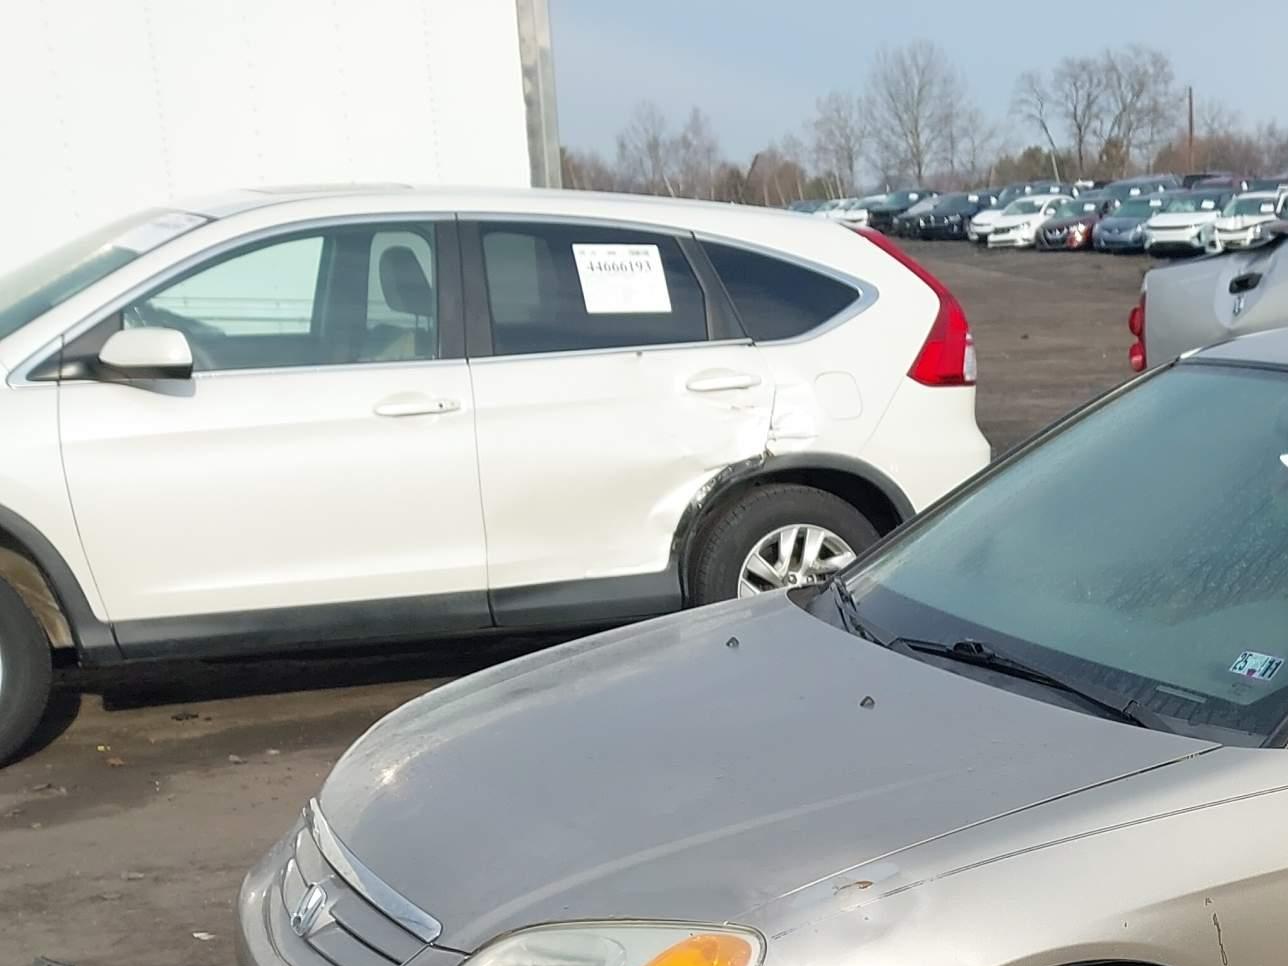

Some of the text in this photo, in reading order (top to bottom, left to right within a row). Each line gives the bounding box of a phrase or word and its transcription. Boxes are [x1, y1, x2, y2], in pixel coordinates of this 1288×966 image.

[587, 260, 652, 273] 44666193
[1232, 652, 1282, 679] 25 11
